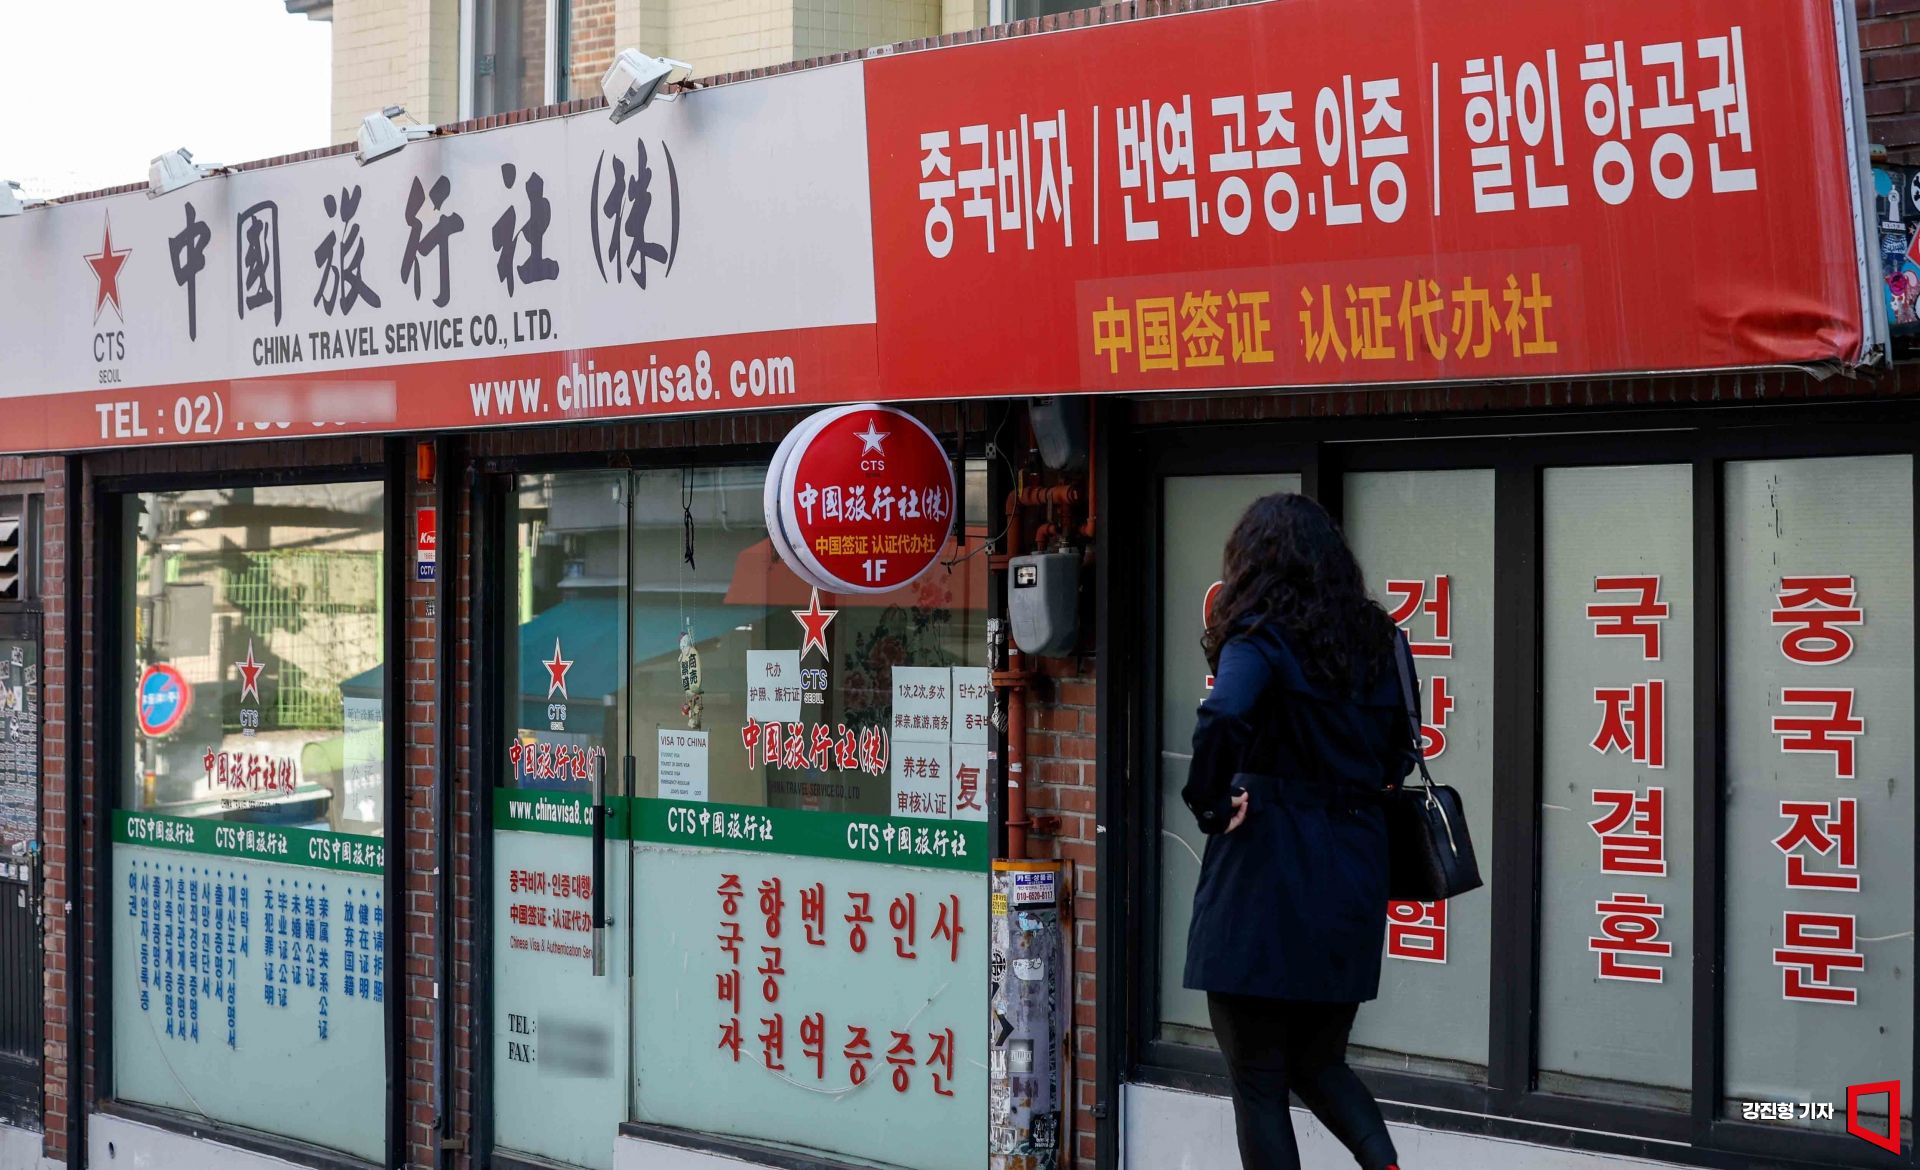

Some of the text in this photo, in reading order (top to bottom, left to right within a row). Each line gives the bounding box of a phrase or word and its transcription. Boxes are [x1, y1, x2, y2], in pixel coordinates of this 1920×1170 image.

[919, 108, 1073, 259] 중국비자
[1461, 48, 1569, 213] 할인
[1579, 26, 1757, 205] 항공권
[252, 308, 558, 366] CHINA TRAVEL SERVICE CO., LTD.
[1092, 272, 1559, 374] 中国签证 认证代办社
[93, 330, 125, 362] CTS
[98, 368, 122, 384] SEOUL
[95, 401, 148, 439] TEL
[860, 460, 885, 471] CTS
[815, 533, 936, 556] 中国签证 认证代办社
[862, 559, 887, 582] 1F
[766, 662, 781, 677] 代办
[800, 669, 828, 691] CTS
[239, 709, 259, 728] CTS
[548, 703, 566, 721] CTS
[803, 692, 825, 704] SEOUL
[660, 735, 707, 748] VISA TO CHINA
[903, 756, 941, 779] 养老金
[956, 762, 989, 812] 复
[1586, 575, 1672, 983] 국제결혼
[897, 791, 947, 815] 审核认证
[1771, 575, 1865, 1005] 중국전문
[129, 872, 137, 917] 여권
[202, 882, 210, 999] 사망진단서
[264, 889, 275, 1006] 无犯罪证明
[278, 892, 288, 1008] 毕业证公证
[291, 894, 301, 986] 未婚公证
[305, 896, 315, 988] 结婚公证
[358, 904, 369, 1000] 健在证明
[509, 935, 528, 950] Chinese
[716, 874, 744, 1062] 중국비자
[757, 877, 785, 1071] 항공권
